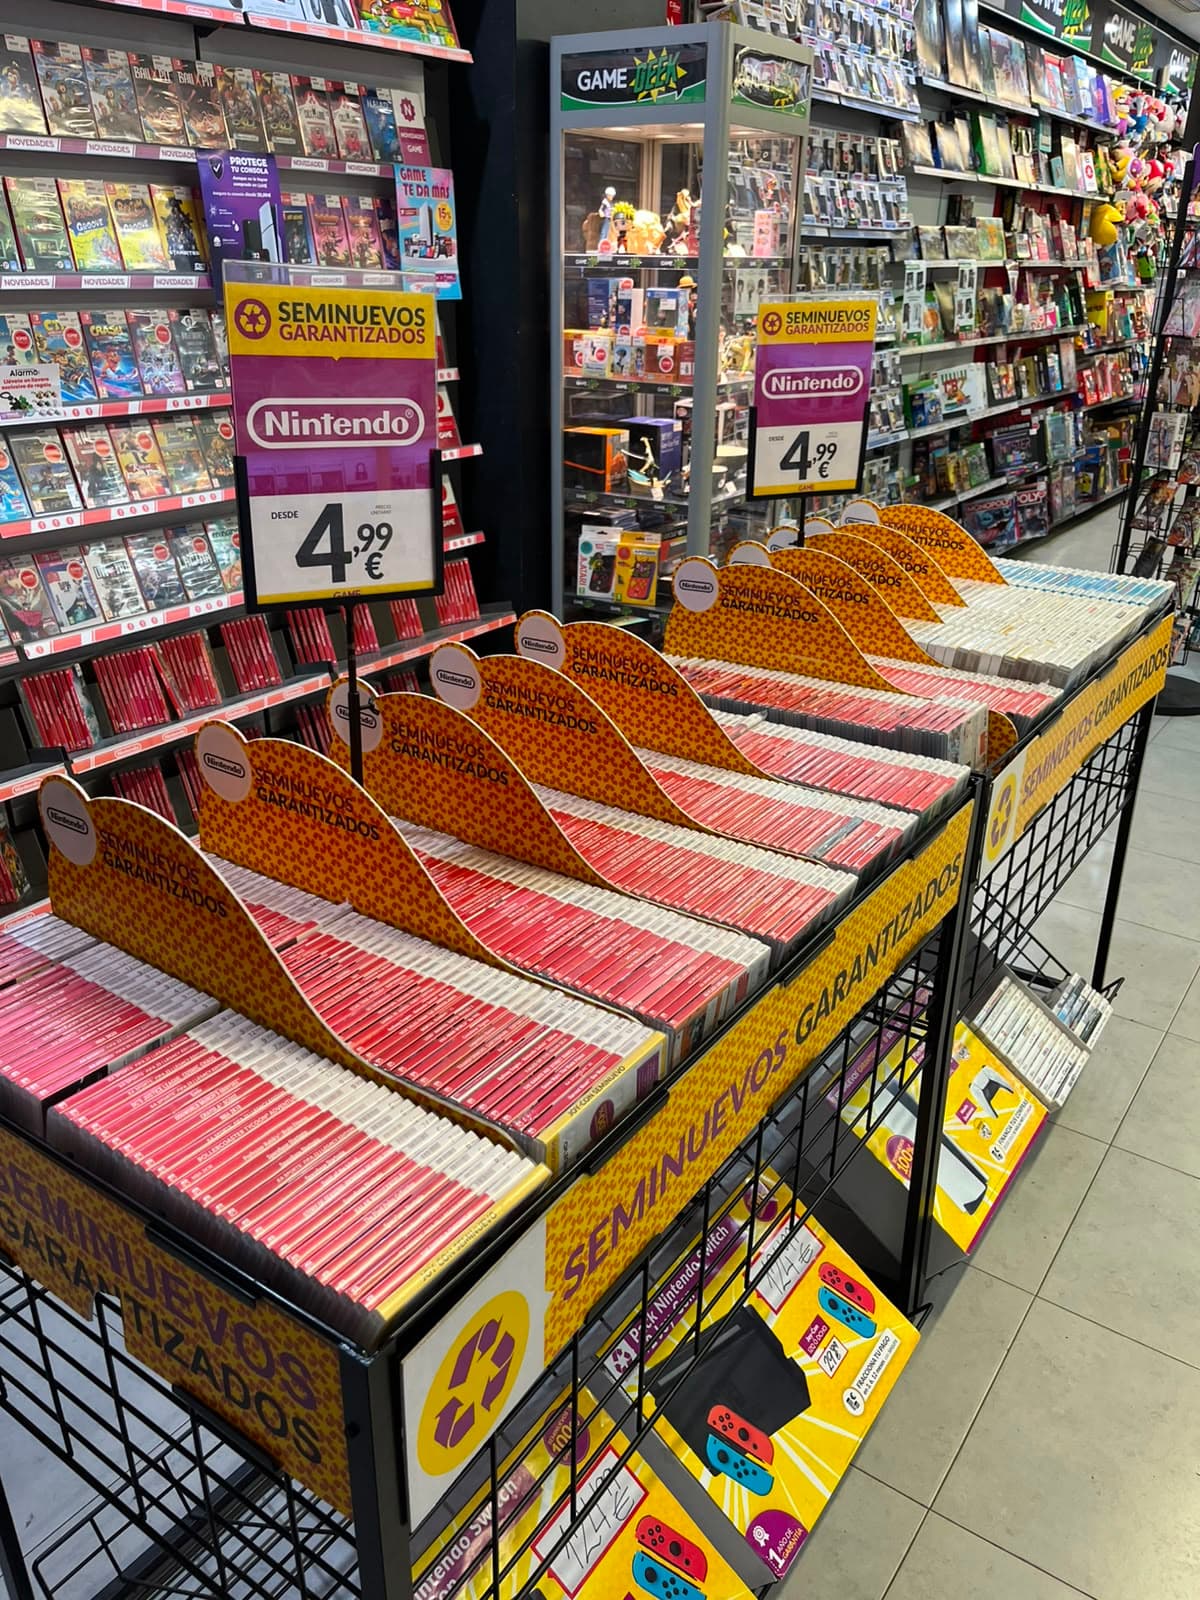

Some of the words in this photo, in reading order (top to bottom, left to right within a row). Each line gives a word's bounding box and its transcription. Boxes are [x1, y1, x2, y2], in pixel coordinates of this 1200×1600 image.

[577, 67, 627, 91] GAME
[633, 51, 681, 94] GEEK
[9, 138, 55, 148] NOVEDADES
[88, 143, 131, 154] NOVEDADES
[407, 144, 423, 153] GAME
[161, 149, 197, 160] NOVEDADE
[229, 156, 268, 167] PROTEGE
[400, 167, 426, 182] GAME
[403, 184, 414, 196] TE
[416, 185, 429, 197] DA
[76, 219, 104, 232] GROOVE
[4, 279, 50, 287] NOVEDADES
[84, 279, 126, 287] NOVEDADES
[155, 279, 194, 287] NOVEDADES
[278, 301, 426, 327] SEMINUEVOS
[786, 309, 871, 324] SEMINUEVOS
[279, 323, 426, 344] GARANTIZADOS
[786, 321, 870, 335] GARANTIZADOS
[10, 368, 39, 376] Alarmo
[771, 373, 855, 393] Nintendo
[264, 410, 410, 437] Nintendo
[271, 510, 299, 520] DESDE
[681, 581, 712, 592] Nintendo
[721, 584, 801, 606] SEMINUEVOS
[721, 598, 819, 623] GARANTIZADOS
[525, 639, 556, 652] Nintendo
[572, 646, 658, 677] SEMINUEVOS
[439, 672, 473, 686] Nintendo
[572, 661, 679, 697] GARANTIZADOS
[485, 679, 576, 712] SEMINUEVOS
[486, 695, 598, 735] GARANTIZADOS
[1022, 710, 1093, 806] SEMINUEVOS
[1094, 644, 1171, 728] GARANTIZADOS
[390, 720, 486, 761] SEMINUEVOS
[206, 756, 243, 775] Nintendo
[390, 738, 510, 787] GARANTIZADOS
[255, 767, 355, 813] SEMINUEVOS
[50, 811, 87, 833] Nintendo
[256, 786, 380, 841] GARANTIZADOS
[100, 831, 200, 885] SEMINUEVOS
[102, 850, 229, 918] GARANTIZADOS
[564, 1030, 789, 1302] SEMINUEVOS
[793, 852, 963, 1046] GARANTIZADOS
[592, 1063, 626, 1095] SEMINUEVO
[651, 1258, 703, 1312] Nintendo
[3, 1210, 322, 1466] GARATIZADOS
[876, 1334, 892, 1351] PAGO
[872, 1348, 883, 1360] TU
[853, 1358, 880, 1389] FRACCIONA
[784, 1527, 794, 1537] DE
[774, 1535, 789, 1553] AÑO
[766, 1549, 785, 1566] 1
